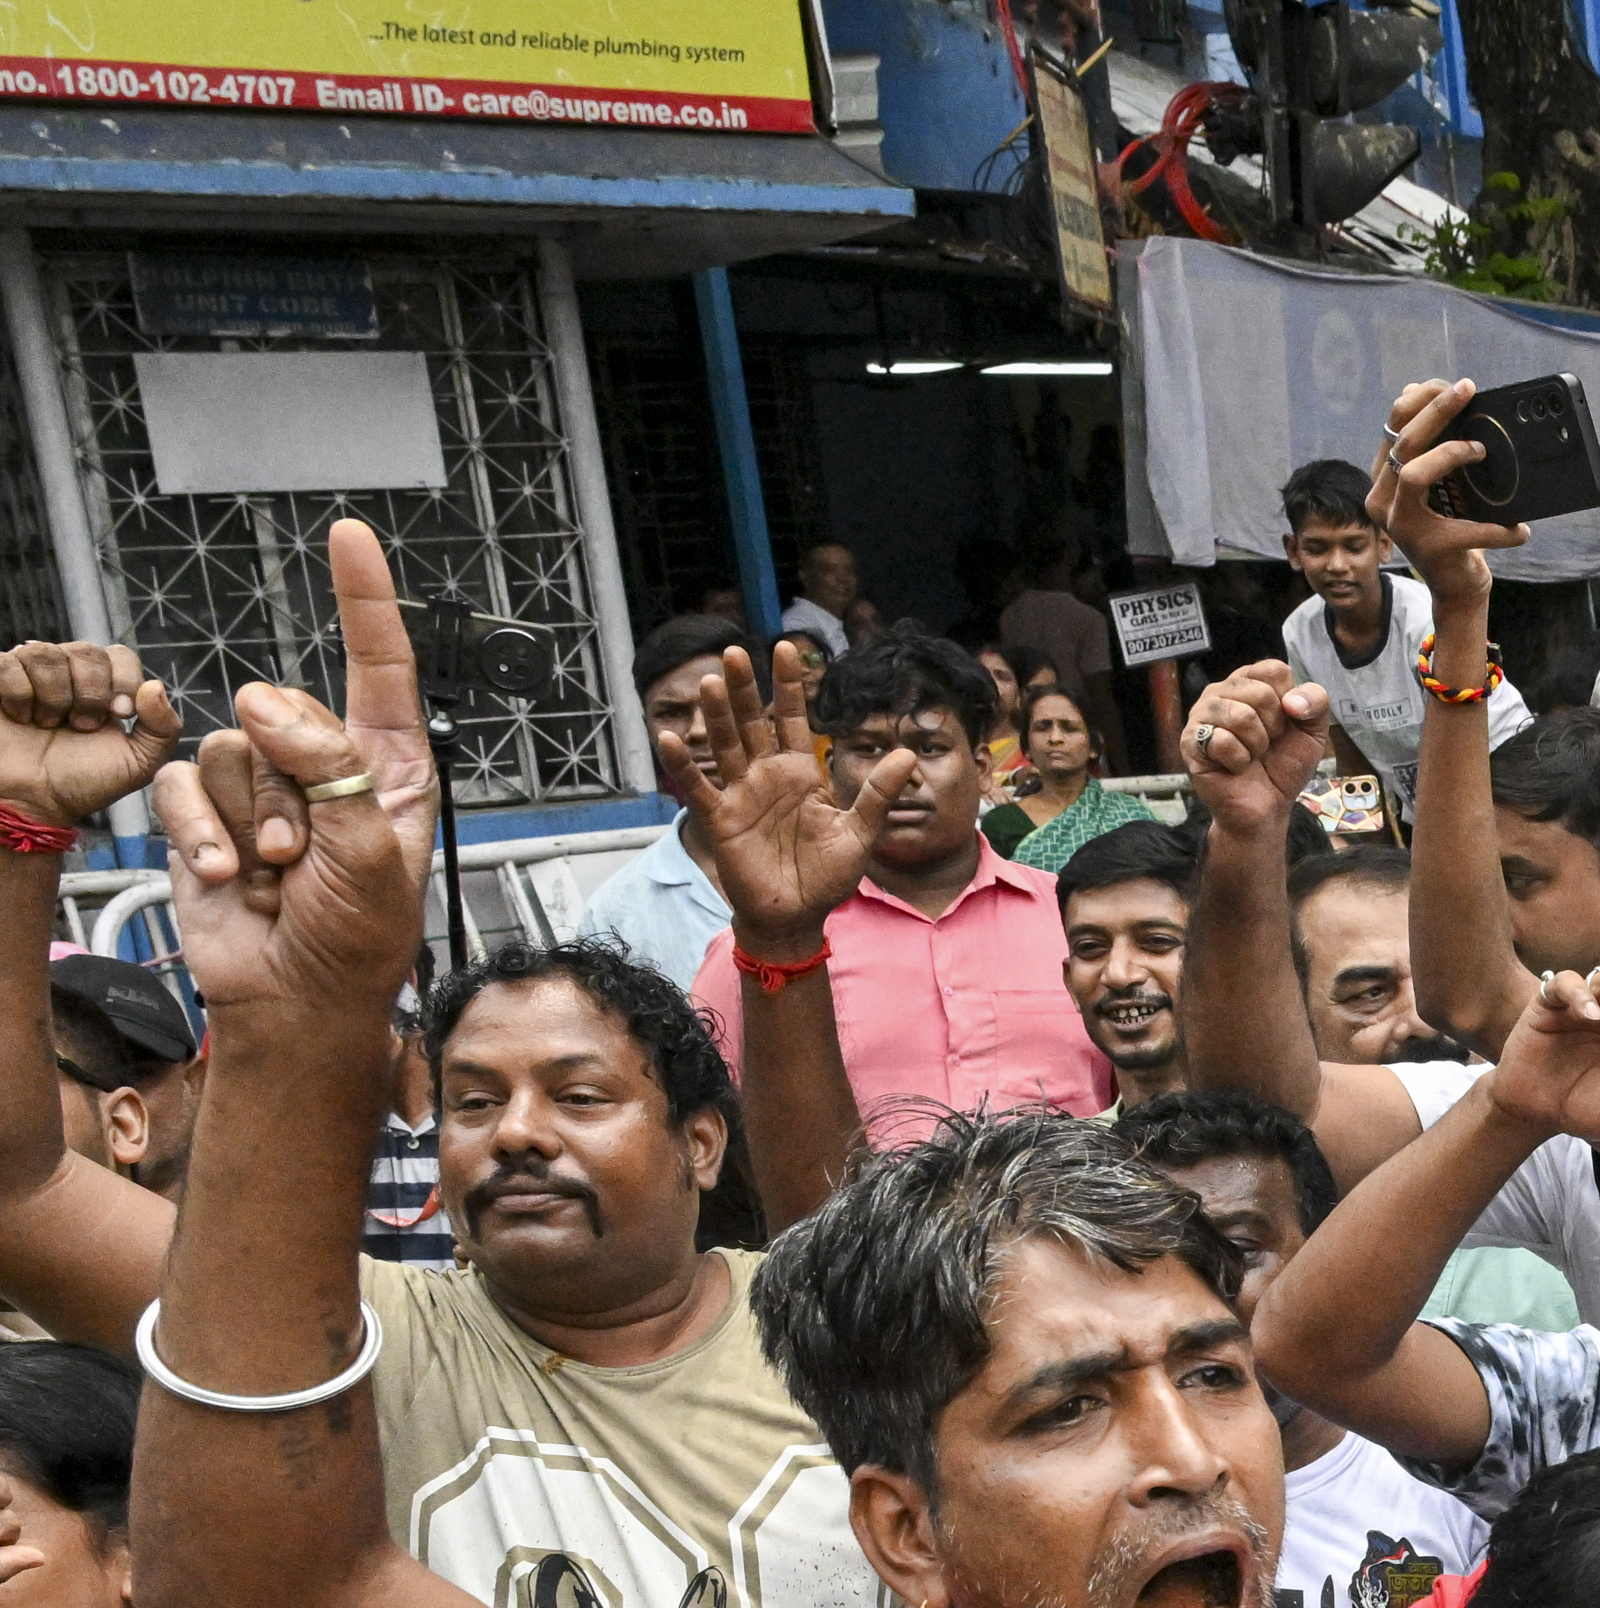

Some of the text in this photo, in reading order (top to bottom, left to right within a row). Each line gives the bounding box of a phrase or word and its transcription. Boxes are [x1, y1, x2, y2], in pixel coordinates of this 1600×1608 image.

[424, 25, 474, 46] latest
[480, 27, 516, 48] and
[521, 31, 588, 54] reliable
[593, 36, 681, 64] plumbing
[685, 45, 745, 65] system
[57, 65, 295, 107] 1800-102-4707
[315, 79, 404, 112] Email
[412, 83, 455, 113] ID-
[463, 89, 748, 129] care@supreme.co.in
[174, 293, 340, 317] UNIT CODE
[1119, 590, 1194, 618] PHYSICS
[1130, 613, 1159, 628] CLASS
